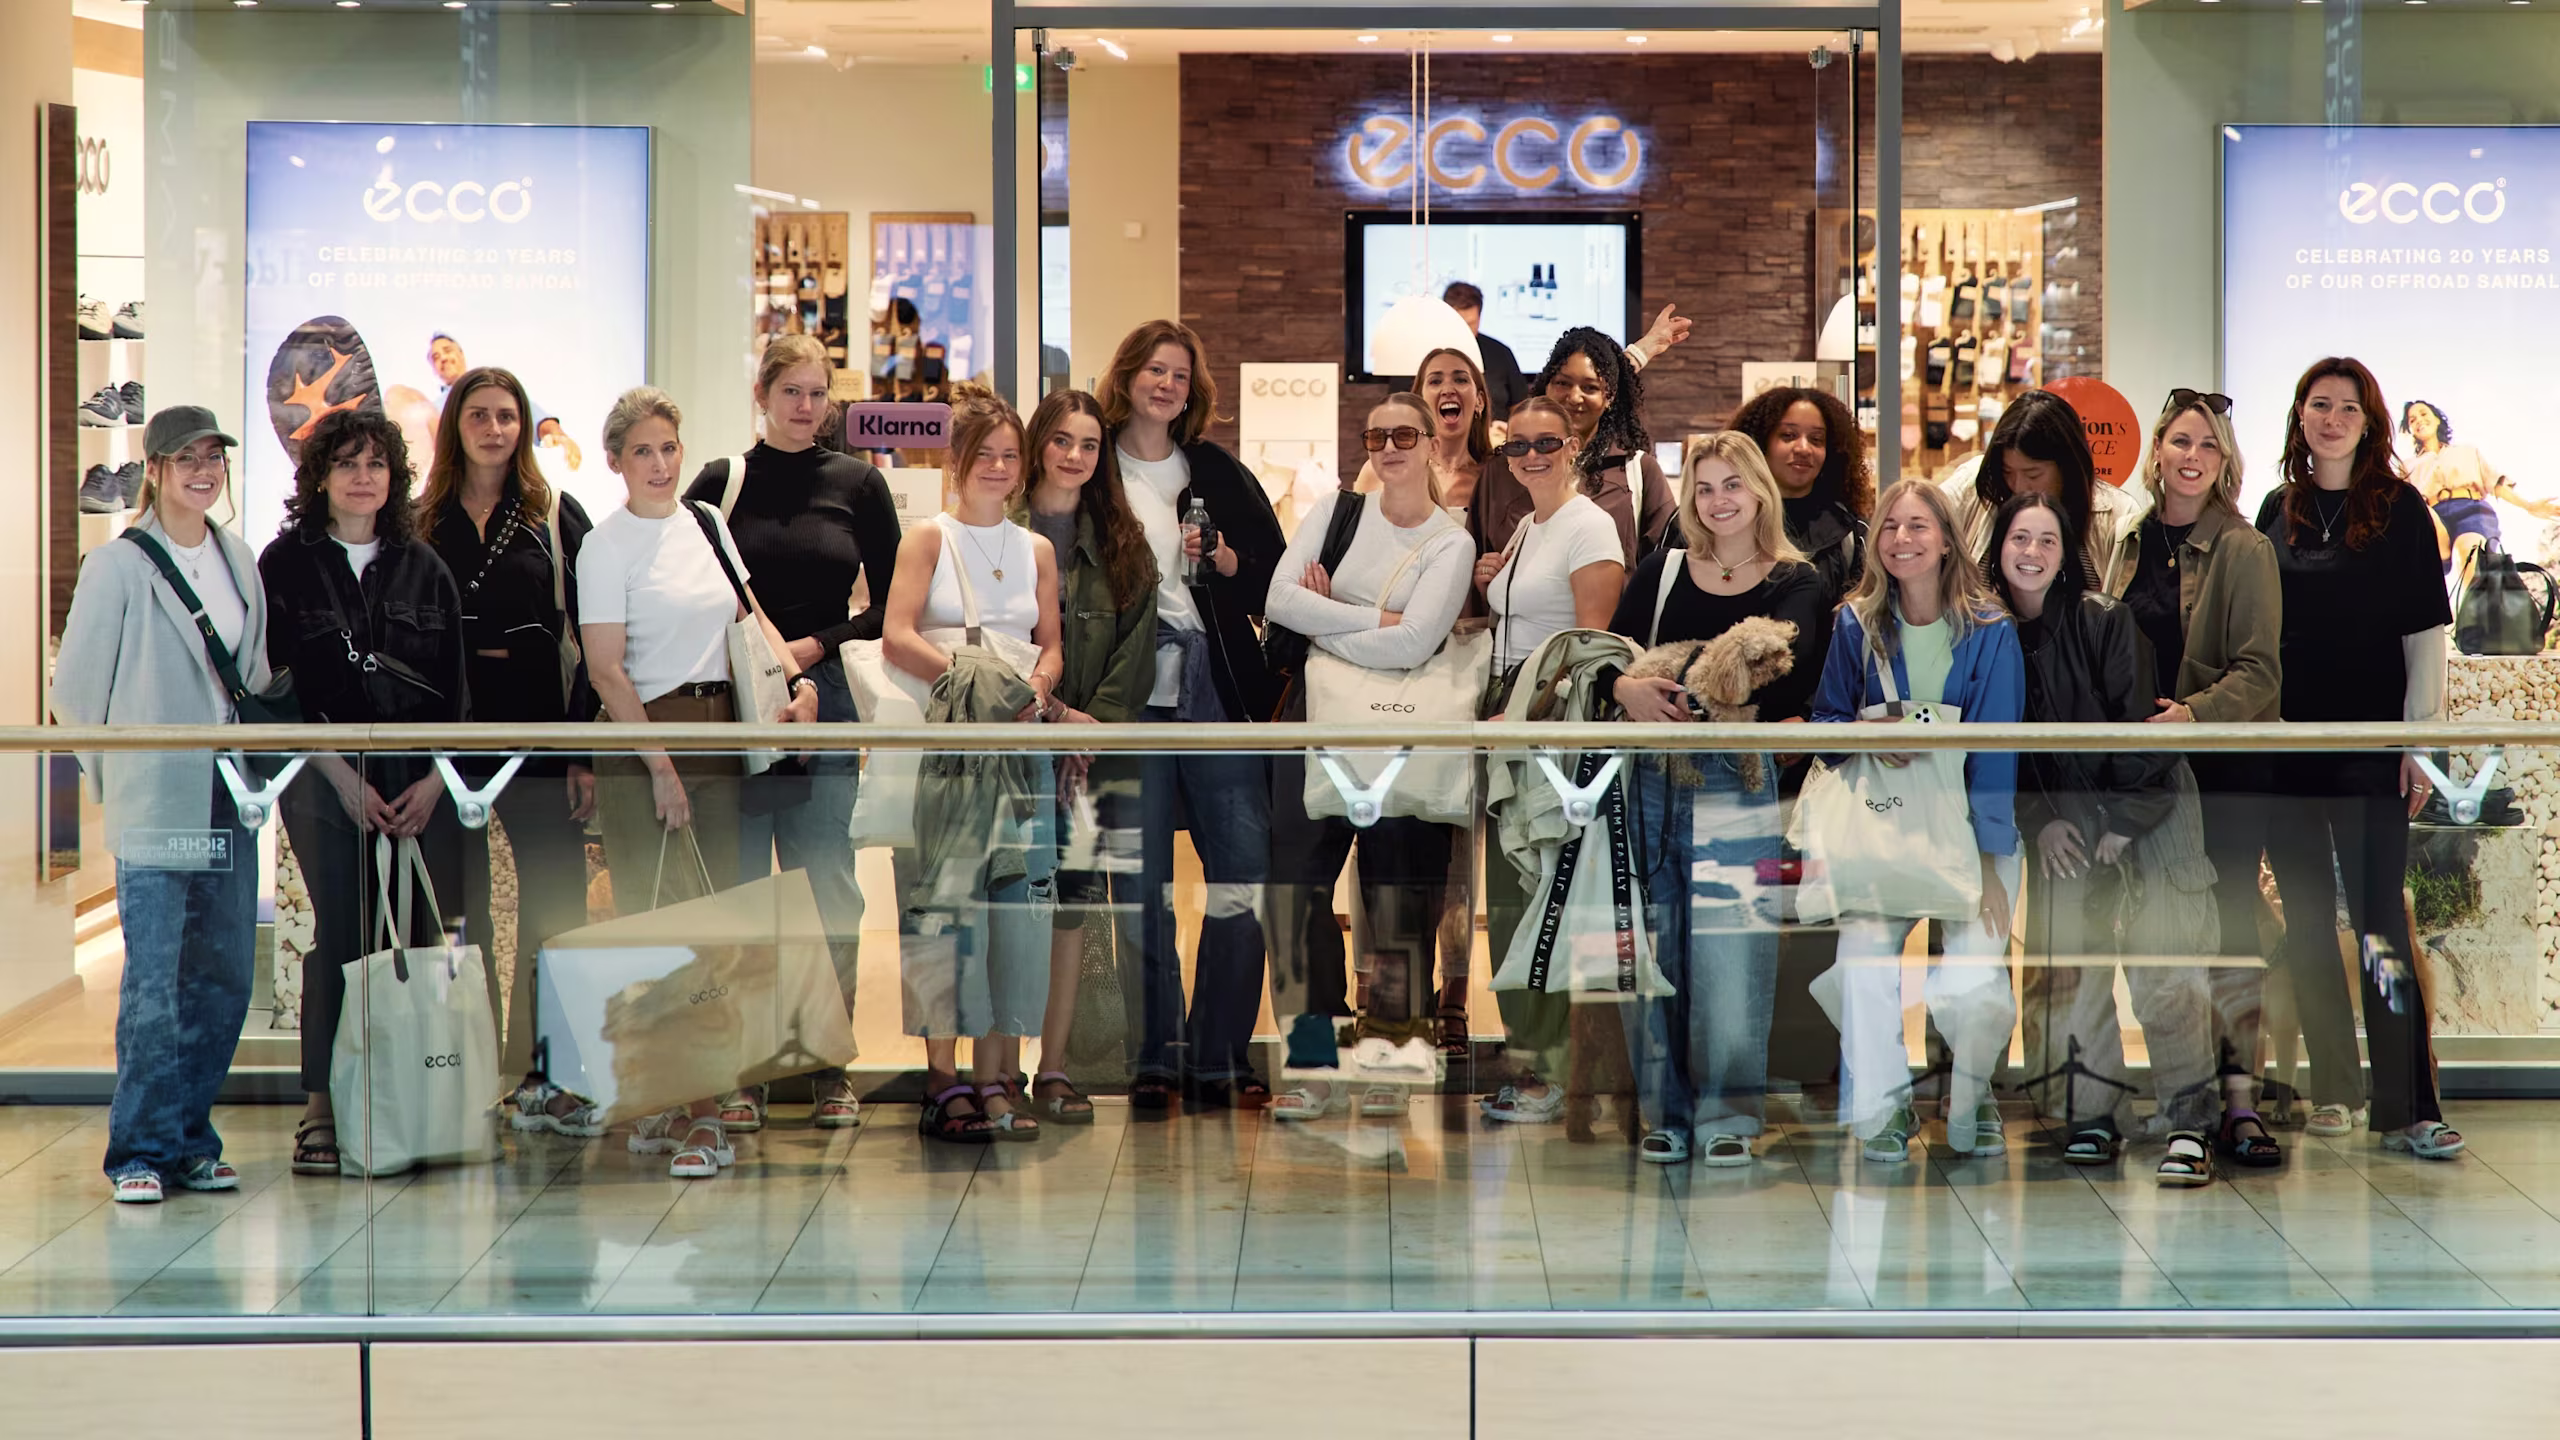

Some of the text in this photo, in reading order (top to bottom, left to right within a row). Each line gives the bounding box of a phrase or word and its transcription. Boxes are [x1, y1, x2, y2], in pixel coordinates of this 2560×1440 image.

[1347, 116, 1641, 189] ecco
[318, 246, 577, 265] CELEBRATING 20 YEARS
[2295, 248, 2551, 264] CELEBRATING 20 YEARS
[308, 272, 337, 287] OF
[344, 272, 386, 288] OUR
[393, 273, 495, 289] OFFROAD
[2286, 274, 2560, 289] OF OUR OFFROAD SANDAL
[1251, 378, 1327, 397] ecco
[859, 415, 941, 436] Klarna
[2089, 440, 2117, 455] CE
[765, 664, 782, 677] MAD
[1370, 702, 1416, 713] ecco
[1865, 796, 1903, 812] ecco
[1540, 901, 1560, 951] FAIRLY
[1619, 902, 1631, 952] JIMMY
[690, 985, 729, 1004] ecco
[424, 1053, 461, 1068] ecco
